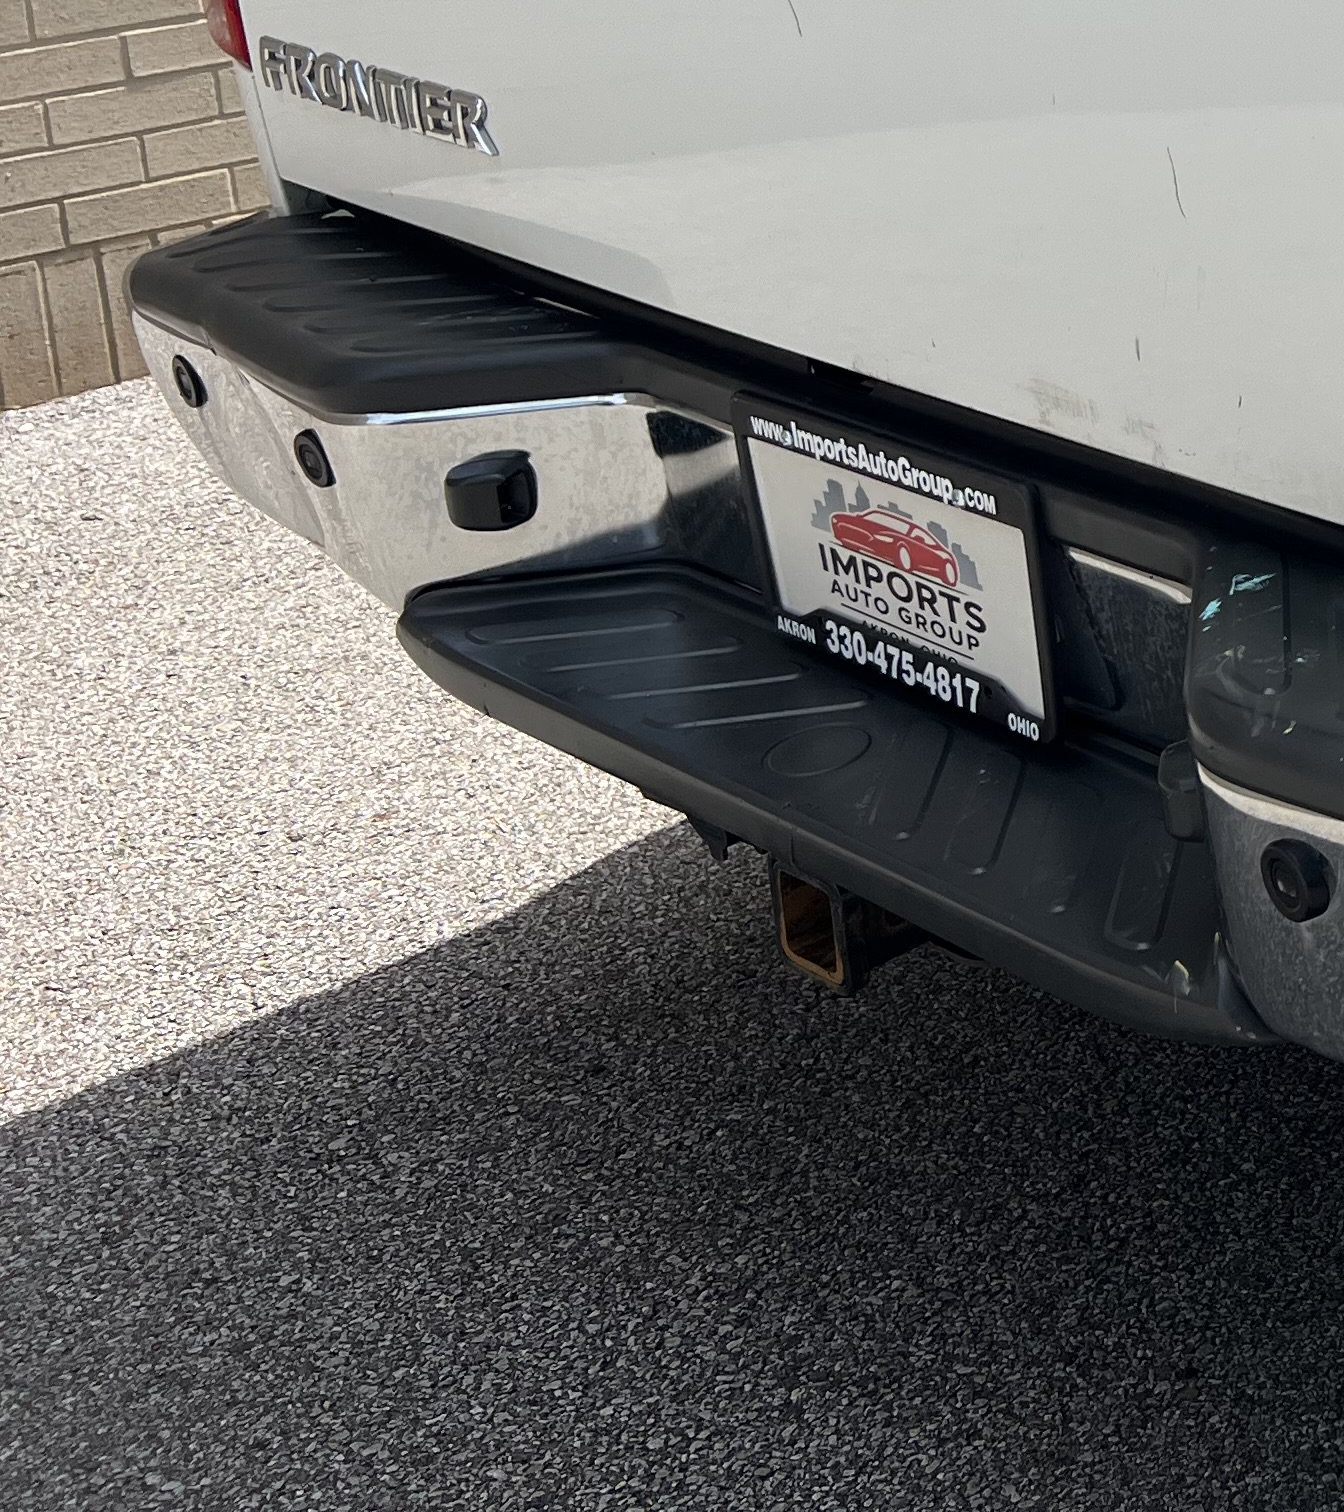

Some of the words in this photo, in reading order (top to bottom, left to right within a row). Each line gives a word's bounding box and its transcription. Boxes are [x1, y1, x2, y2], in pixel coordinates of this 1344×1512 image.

[259, 35, 499, 156] FRONTIER
[818, 542, 987, 634] IMPORTS
[830, 578, 889, 615] AUTO
[898, 606, 980, 651] GROUP
[776, 615, 816, 644] AKRON
[825, 620, 980, 713] 330-475-4817
[1007, 713, 1040, 741] OHIO
